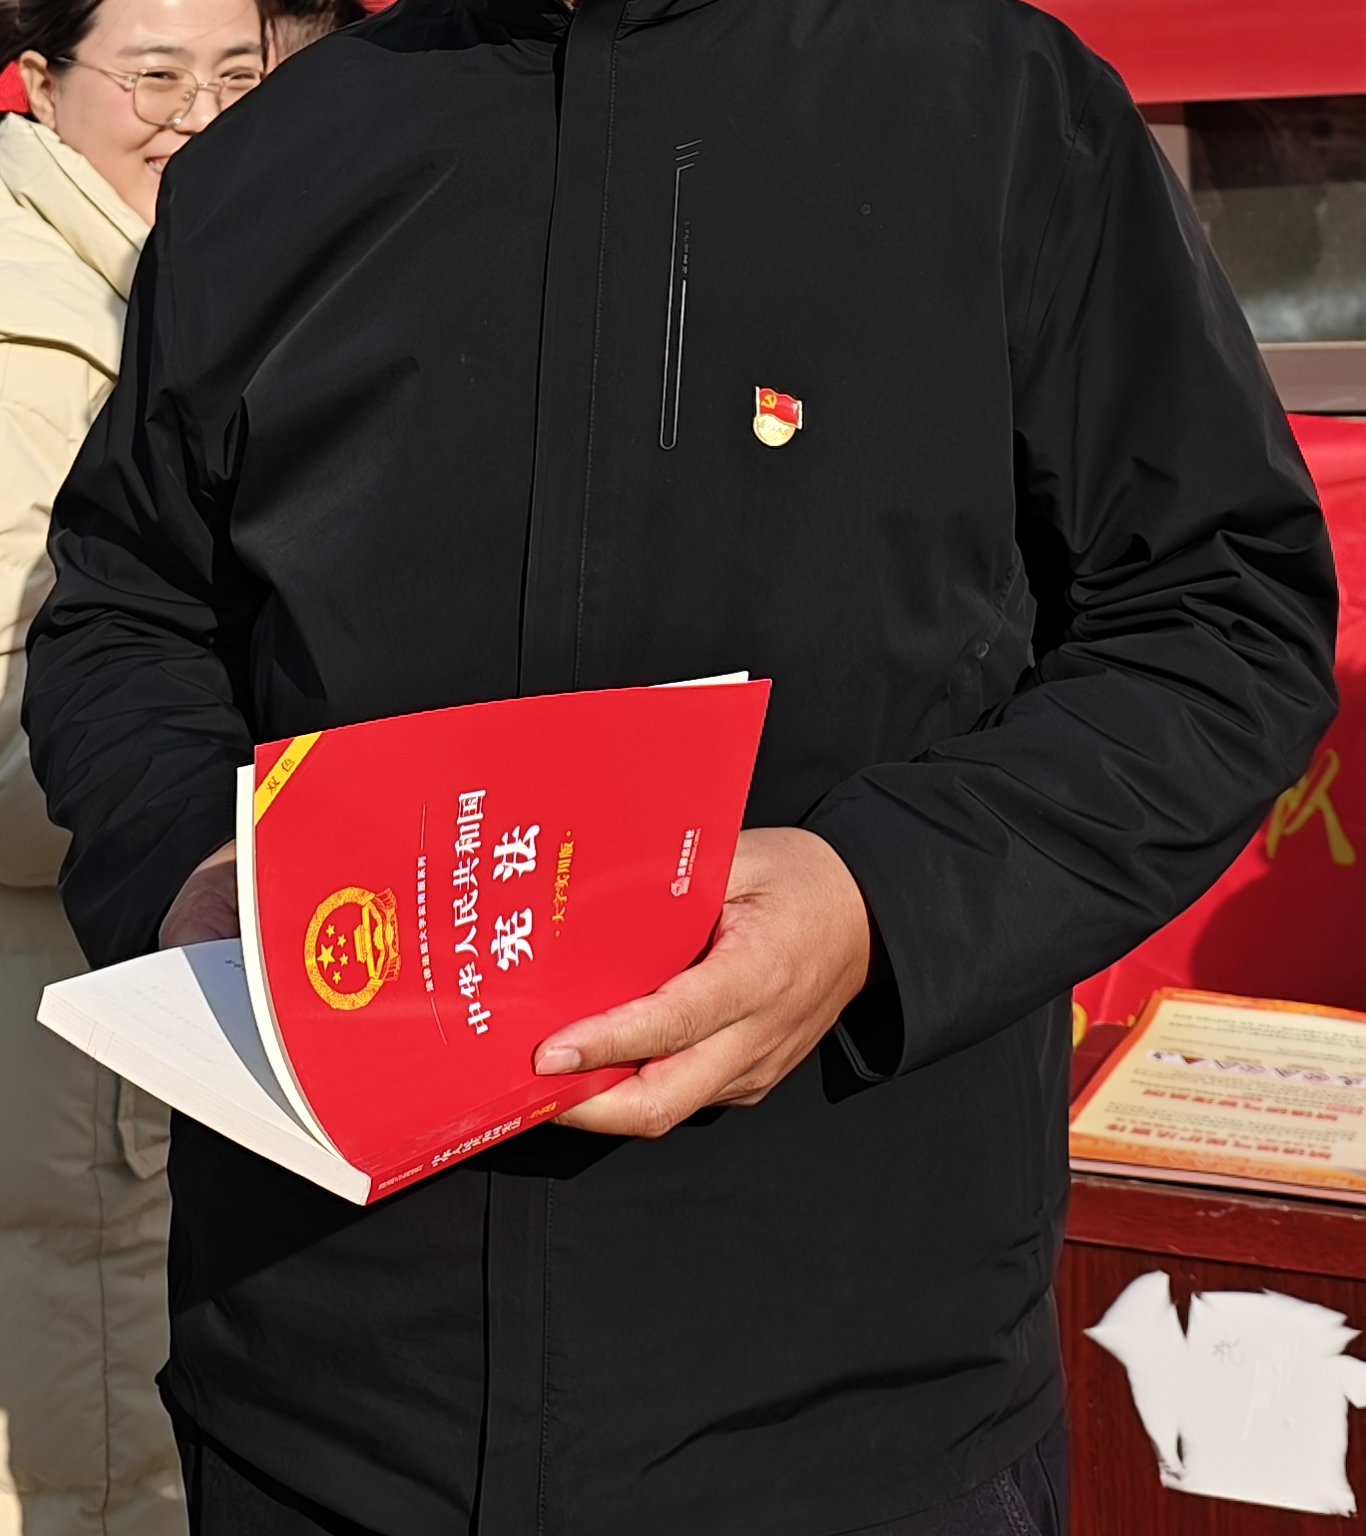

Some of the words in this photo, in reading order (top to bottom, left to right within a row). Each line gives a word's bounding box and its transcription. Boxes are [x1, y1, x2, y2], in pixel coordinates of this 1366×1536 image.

[451, 788, 492, 1036] 中华人民共和国
[490, 823, 541, 972] 宪法
